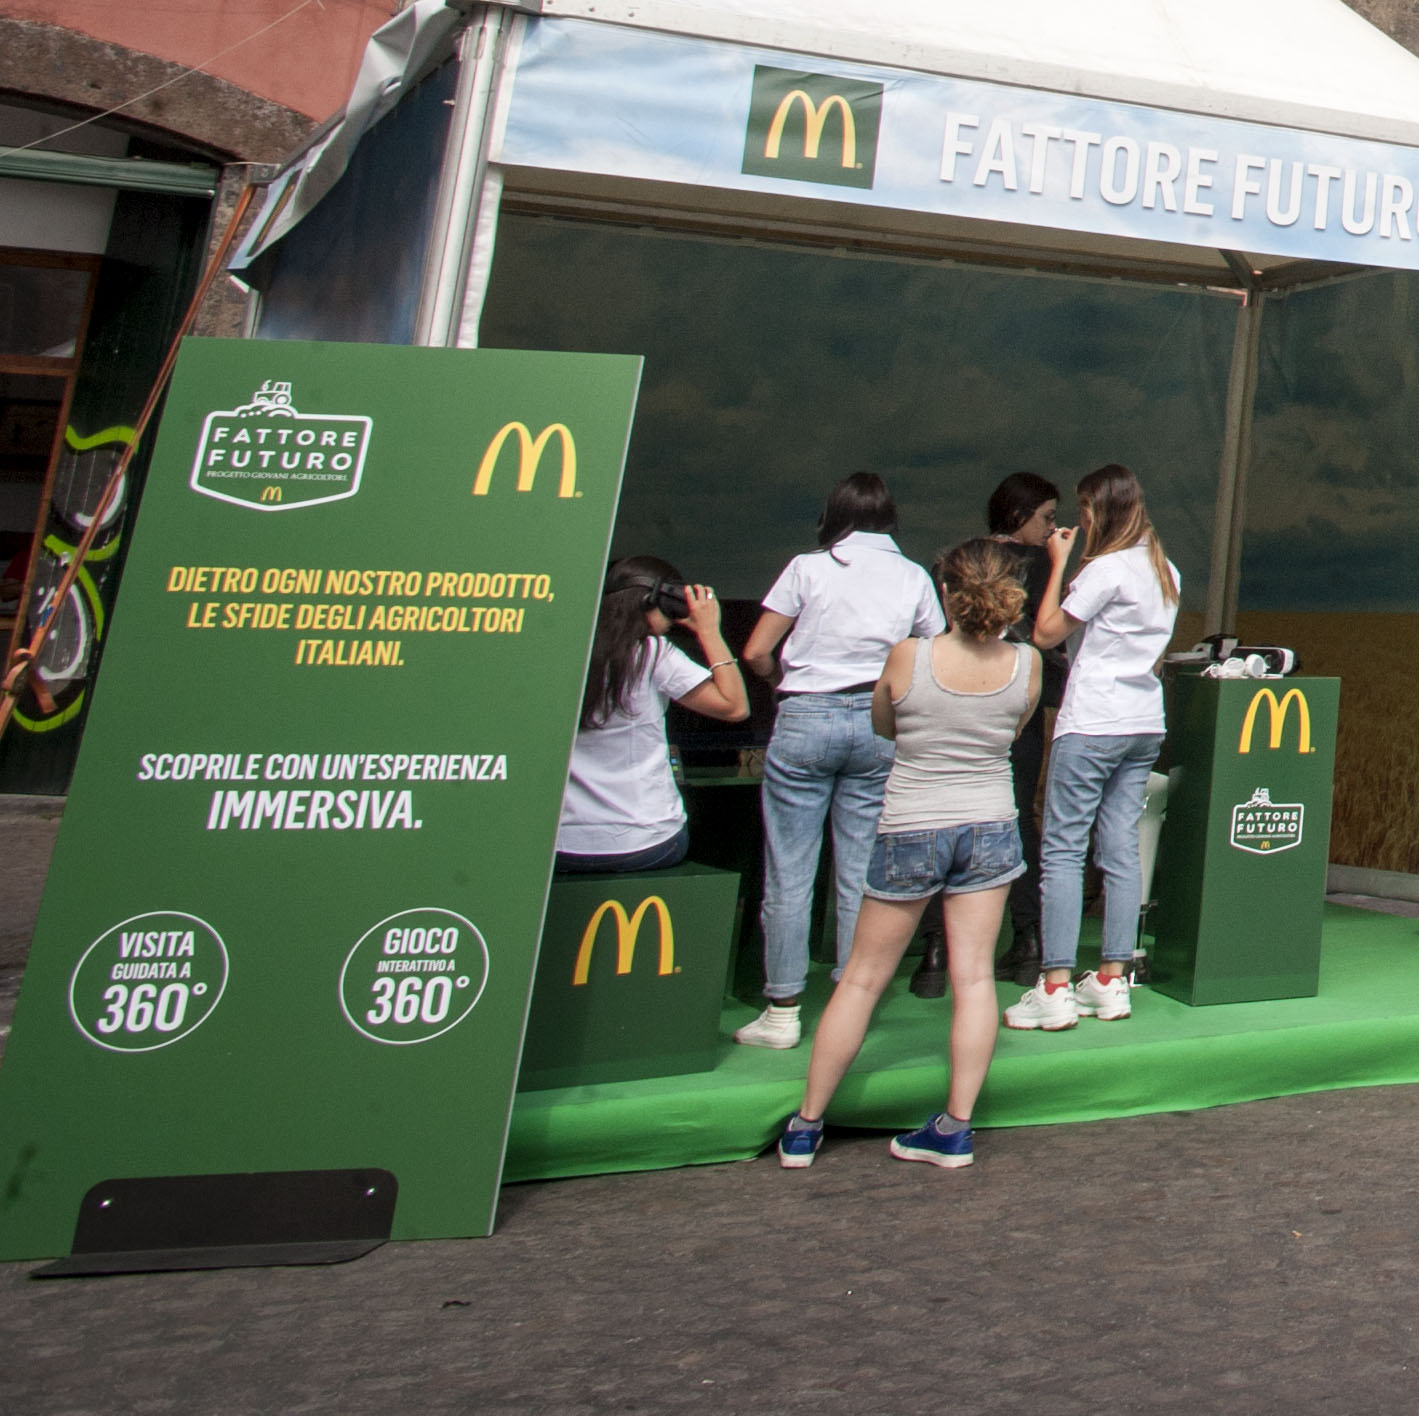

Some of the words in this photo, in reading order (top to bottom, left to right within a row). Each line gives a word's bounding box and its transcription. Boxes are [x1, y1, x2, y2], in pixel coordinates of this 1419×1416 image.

[939, 111, 1219, 216] FATTORE
[212, 427, 359, 448] FATTORE
[207, 449, 353, 472] FUTURO
[166, 566, 258, 593] DIETRO
[260, 568, 322, 594] OGNI
[324, 569, 422, 597] NOSTRO
[425, 571, 555, 602] PRODOTTO,
[186, 602, 216, 628] LE
[222, 602, 293, 629] SFIDE
[295, 604, 365, 631] DEGLI
[368, 605, 524, 633] AGRICOLTORI
[295, 639, 405, 666] ITALIANI.
[137, 753, 262, 781] SCOPRILE
[264, 753, 317, 781] CON
[321, 753, 508, 781] UN'ESPERIENZA
[206, 789, 423, 830] IMMERSIVA.
[1237, 811, 1298, 822] FATTORE
[1236, 823, 1298, 834] FUTURO
[118, 930, 196, 958] VISITA
[383, 927, 460, 955] GIOCO
[110, 963, 179, 980] GUIDATA
[178, 962, 192, 979] A
[376, 959, 444, 973] INTERATTIVO
[444, 959, 456, 972] A
